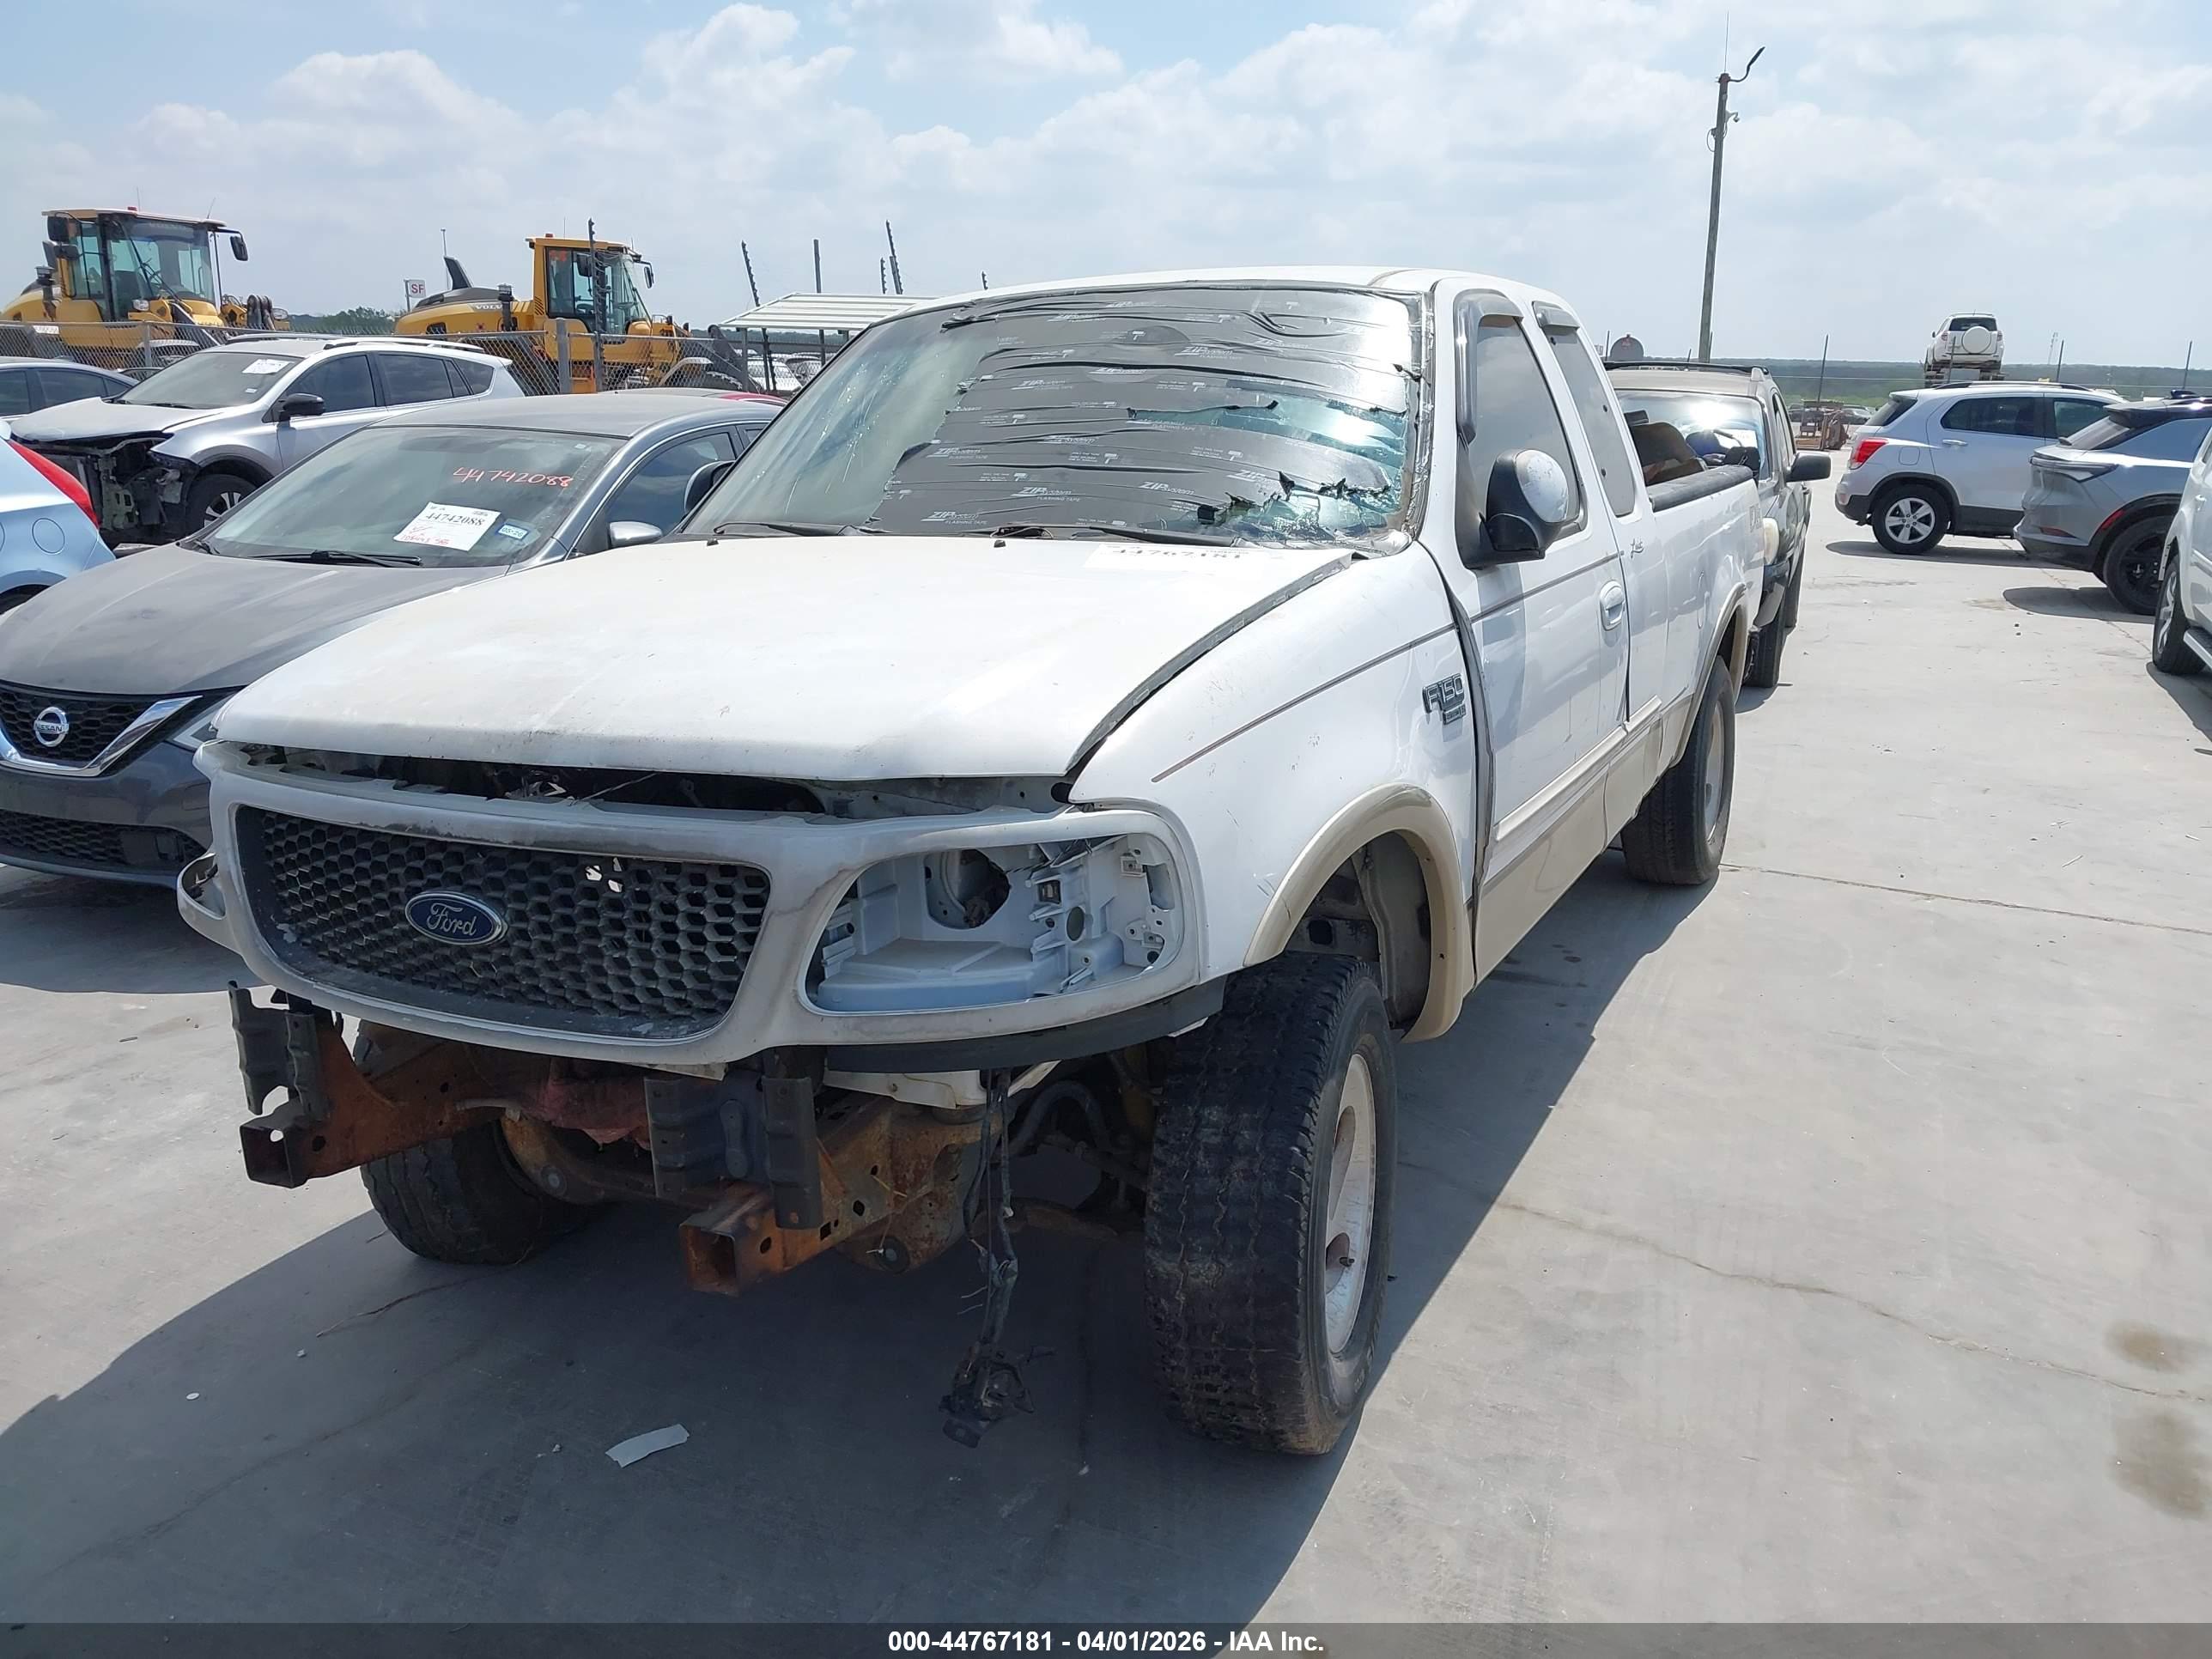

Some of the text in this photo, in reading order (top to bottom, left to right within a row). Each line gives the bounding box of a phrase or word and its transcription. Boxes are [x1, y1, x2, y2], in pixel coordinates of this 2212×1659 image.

[410, 283, 425, 294] SF
[453, 467, 574, 487] 44742088
[426, 513, 485, 526] 44742088
[427, 902, 477, 936] Ford
